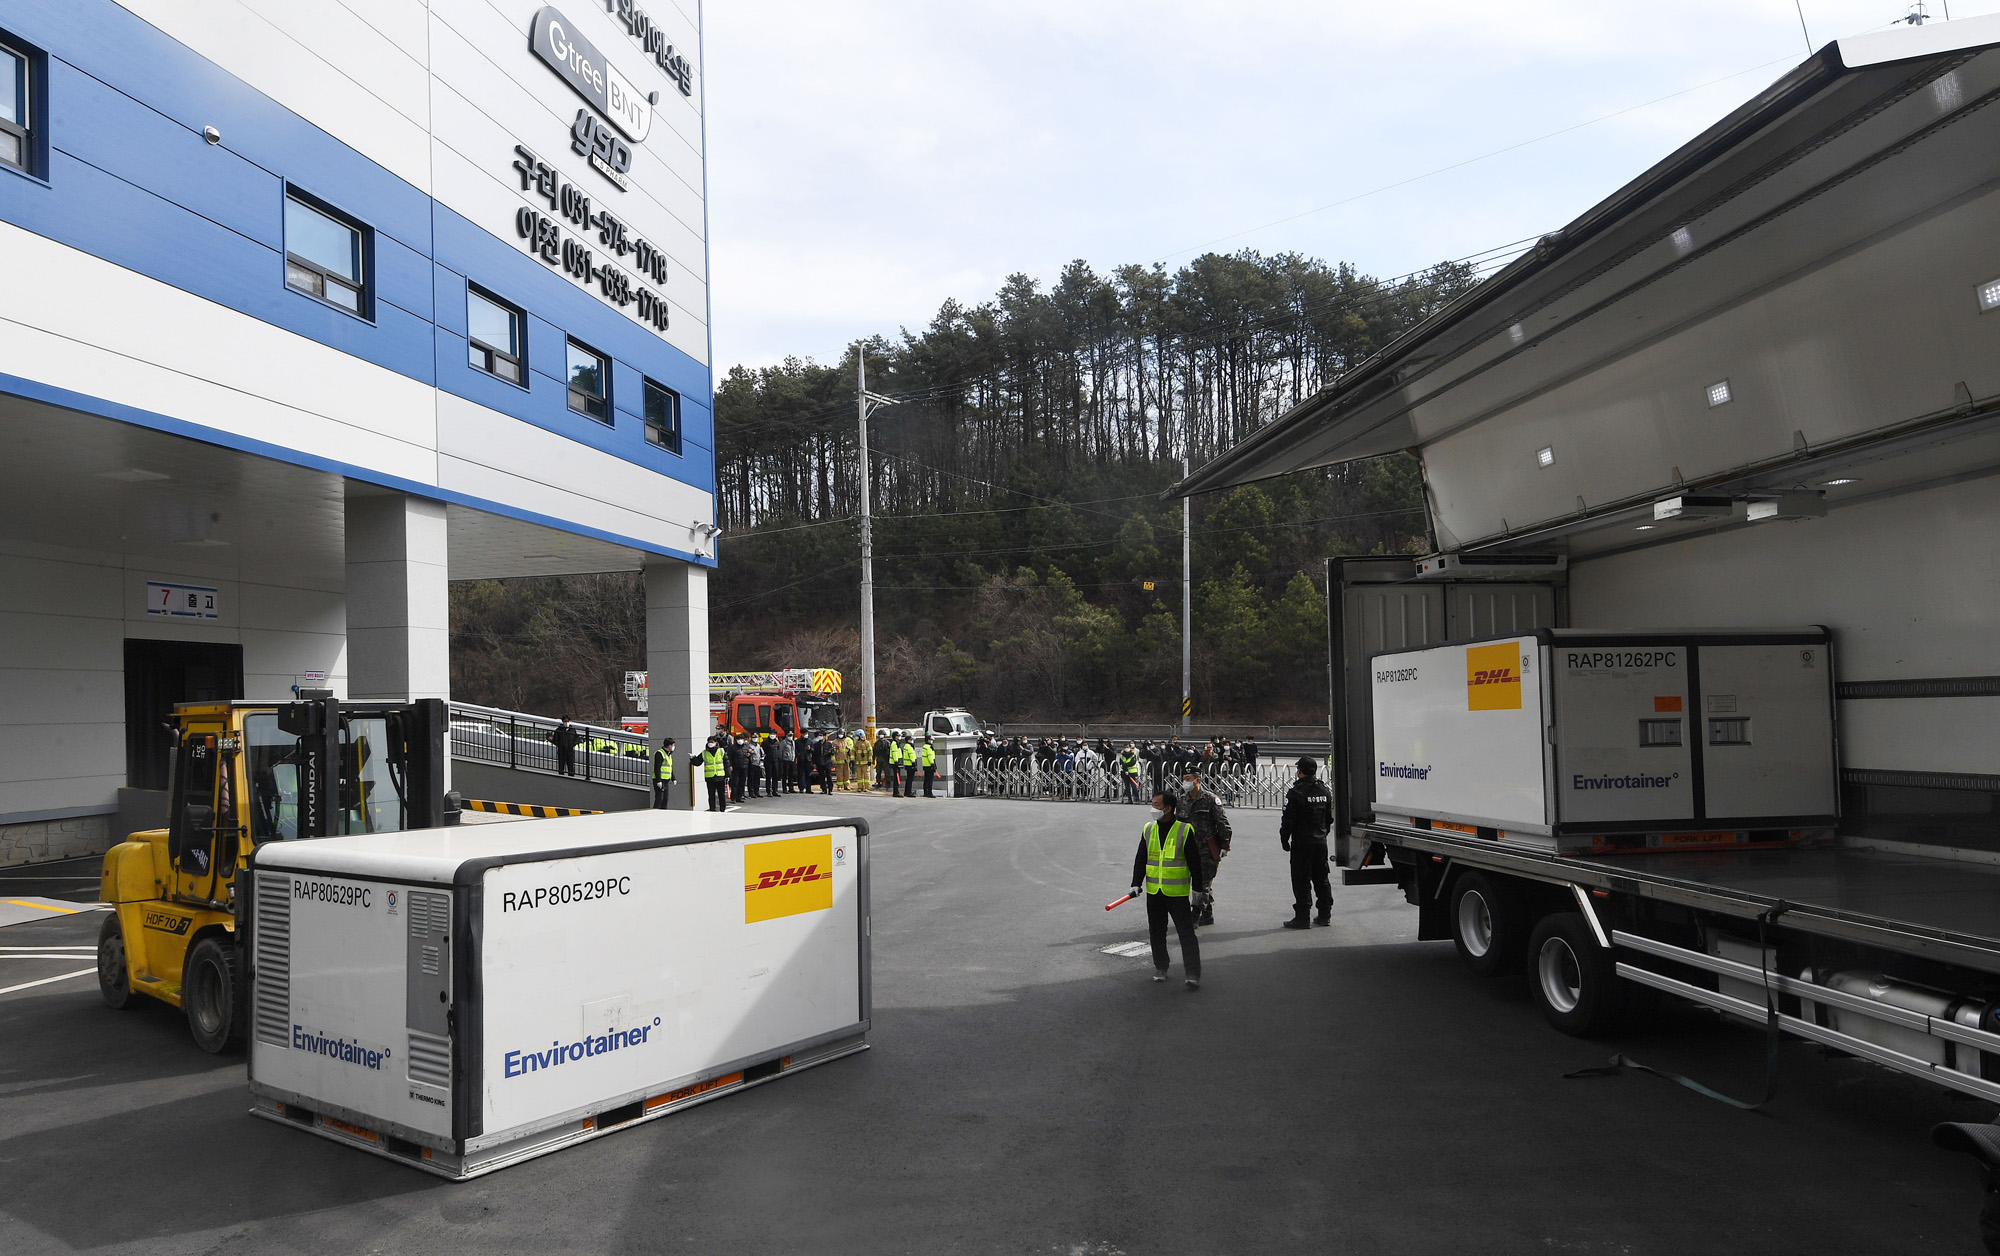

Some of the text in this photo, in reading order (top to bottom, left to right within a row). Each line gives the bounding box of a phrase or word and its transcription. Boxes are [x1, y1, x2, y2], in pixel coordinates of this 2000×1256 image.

[549, 20, 643, 130] Gtree BNT
[605, 166, 628, 189] PHARM
[513, 145, 668, 284] 구리 031-575-1718
[516, 206, 669, 331] 이천 031-633-1718
[161, 588, 171, 605] 7
[1567, 652, 1677, 669] RAP81262PC
[1376, 667, 1418, 684] RAP81262PC
[1473, 668, 1514, 686] DHL
[1673, 834, 1723, 843] FORK LIFT
[756, 864, 824, 890] DHL
[294, 880, 372, 908] RAP80529PC
[503, 876, 631, 913] RAP80529PC
[670, 1079, 720, 1101] FORK LIFT
